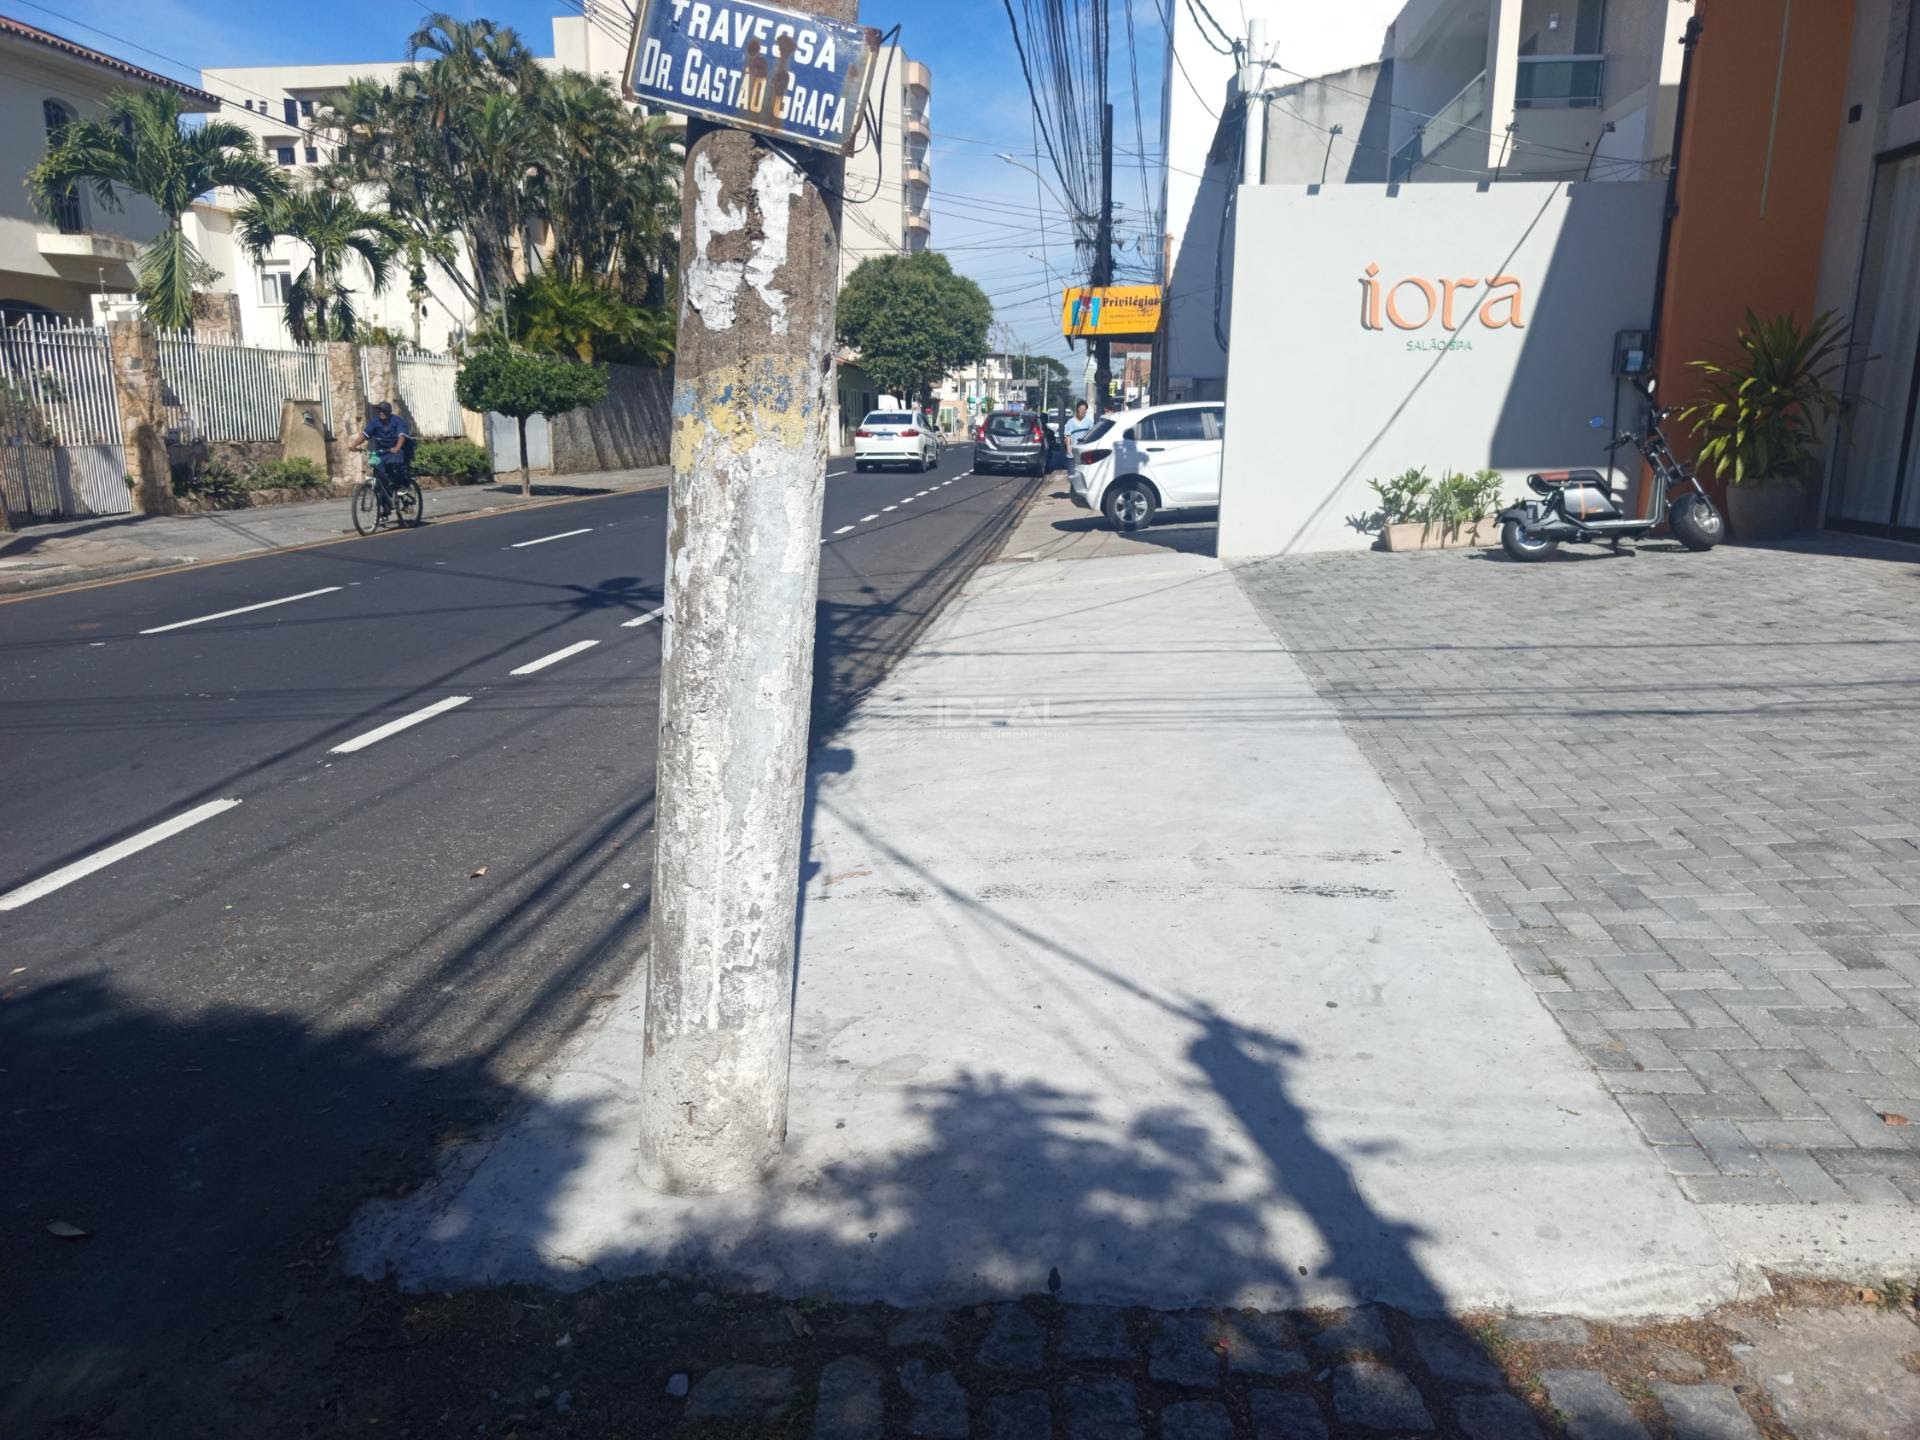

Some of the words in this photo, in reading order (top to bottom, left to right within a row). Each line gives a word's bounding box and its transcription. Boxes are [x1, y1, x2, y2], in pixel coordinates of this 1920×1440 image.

[671, 0, 835, 72] TRAVESSA
[773, 71, 846, 136] GRAÇA
[1361, 262, 1525, 332] iora
